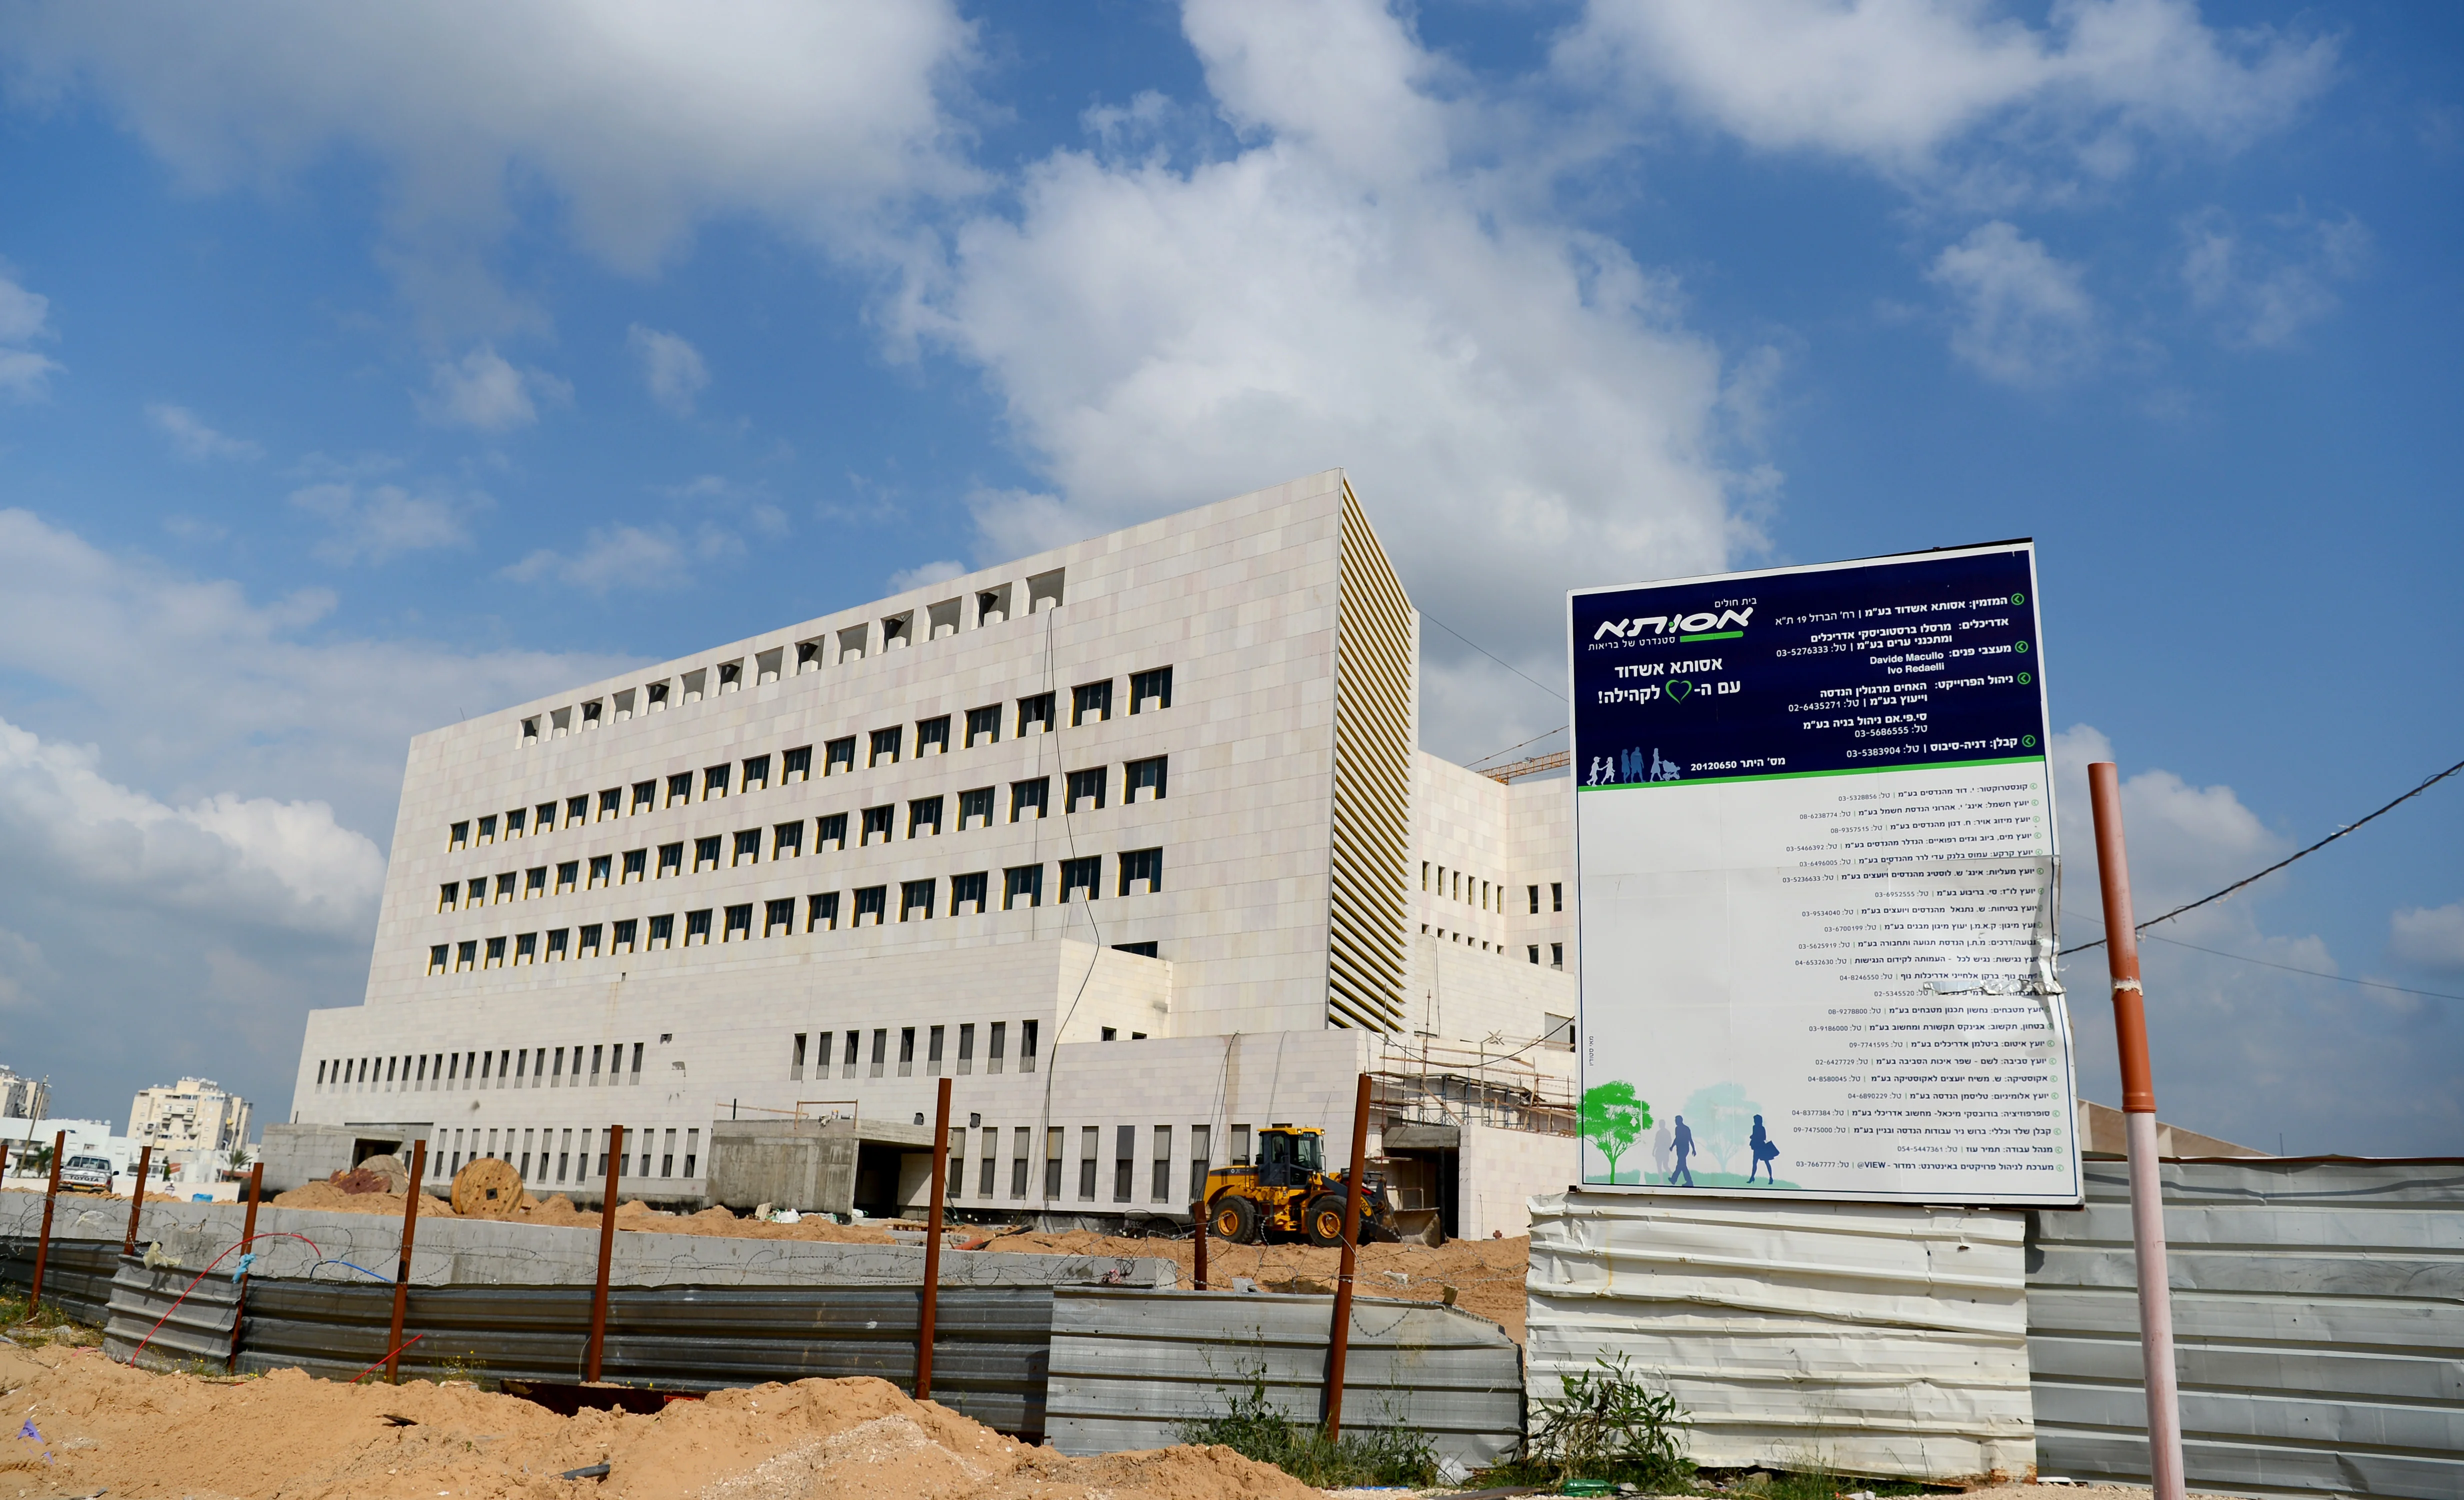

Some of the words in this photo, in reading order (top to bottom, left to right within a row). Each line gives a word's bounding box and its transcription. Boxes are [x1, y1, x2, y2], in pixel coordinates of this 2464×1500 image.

[1714, 599, 1738, 608] חולים
[1931, 600, 1966, 611] אסותא
[1969, 597, 2008, 610] המזמין:
[1894, 604, 1928, 614] אשדוד
[1809, 612, 1837, 622] הברזל
[1594, 607, 1754, 640] אסותא
[1920, 623, 1951, 633] מרסלו
[1958, 618, 2009, 630] אדריכלים:
[1810, 632, 1855, 642] אדריכלים
[1858, 626, 1917, 640] ברסטוביסקי
[1622, 639, 1635, 648] של
[1639, 636, 1675, 646] סטנדרט
[1886, 638, 1911, 648] ערים
[1914, 634, 1952, 645] ומתכנני
[1588, 642, 1619, 650] בריאות
[1831, 642, 1846, 652] טל:
[1978, 644, 2012, 654] מעצבי
[1776, 646, 1828, 657] 03-5276333
[1949, 648, 1975, 658] פנים:
[1870, 654, 1903, 664] Davide
[1905, 651, 1944, 662] Macullo
[1614, 663, 1664, 678] אשדוד
[1670, 658, 1723, 674] אסותא
[1888, 666, 1903, 674] Ivo
[1905, 662, 1944, 673] Redaelli
[1934, 678, 1984, 690] הפרוייקט:
[1987, 675, 2013, 684] ניהול
[1718, 680, 1740, 694] עם
[1856, 685, 1890, 698] מרגולין
[1894, 682, 1927, 692] האחים
[1598, 684, 1660, 704] לקהילה!
[1820, 688, 1852, 698] הנדסה
[1844, 698, 1859, 708] טל:
[1900, 694, 1928, 706] וייעוץ
[1788, 700, 1840, 712] 02-6435271
[1833, 718, 1854, 727] בניה
[1857, 716, 1882, 726] ניהול
[1885, 713, 1927, 724] סי.פי.אם
[1854, 726, 1909, 738] 03-5686555
[1911, 723, 1928, 733] טל:
[1930, 740, 1986, 752] דניה-סיבוס
[1990, 737, 2018, 750] קבלן:
[1846, 746, 1900, 758] 03-5383904
[1903, 744, 1919, 754] טל:
[1690, 760, 1737, 771] 20120650
[1740, 759, 1764, 768] היתר
[1838, 794, 1877, 802] 03-5328856
[2013, 800, 2029, 808] יועץ
[1948, 820, 1960, 828] דנון
[2014, 816, 2030, 824] יועץ
[1830, 826, 1869, 834] 08-9357515
[2016, 833, 2032, 841] יועץ
[1786, 844, 1824, 852] 03-5466392
[1922, 1024, 1955, 1032] תקשורת
[1971, 1040, 1999, 1049] ביטלמן
[2029, 1040, 2045, 1048] יועץ
[1894, 1074, 1938, 1084] לאקוסטיקה
[2004, 1076, 2048, 1084] אקוסטיקה:
[1961, 1092, 1988, 1101] טליסמן
[2032, 1093, 2049, 1101] יועץ
[1837, 1160, 1849, 1168] טל:
[1960, 1164, 1996, 1172] פרויקטים
[1998, 1162, 2023, 1170] לניהול
